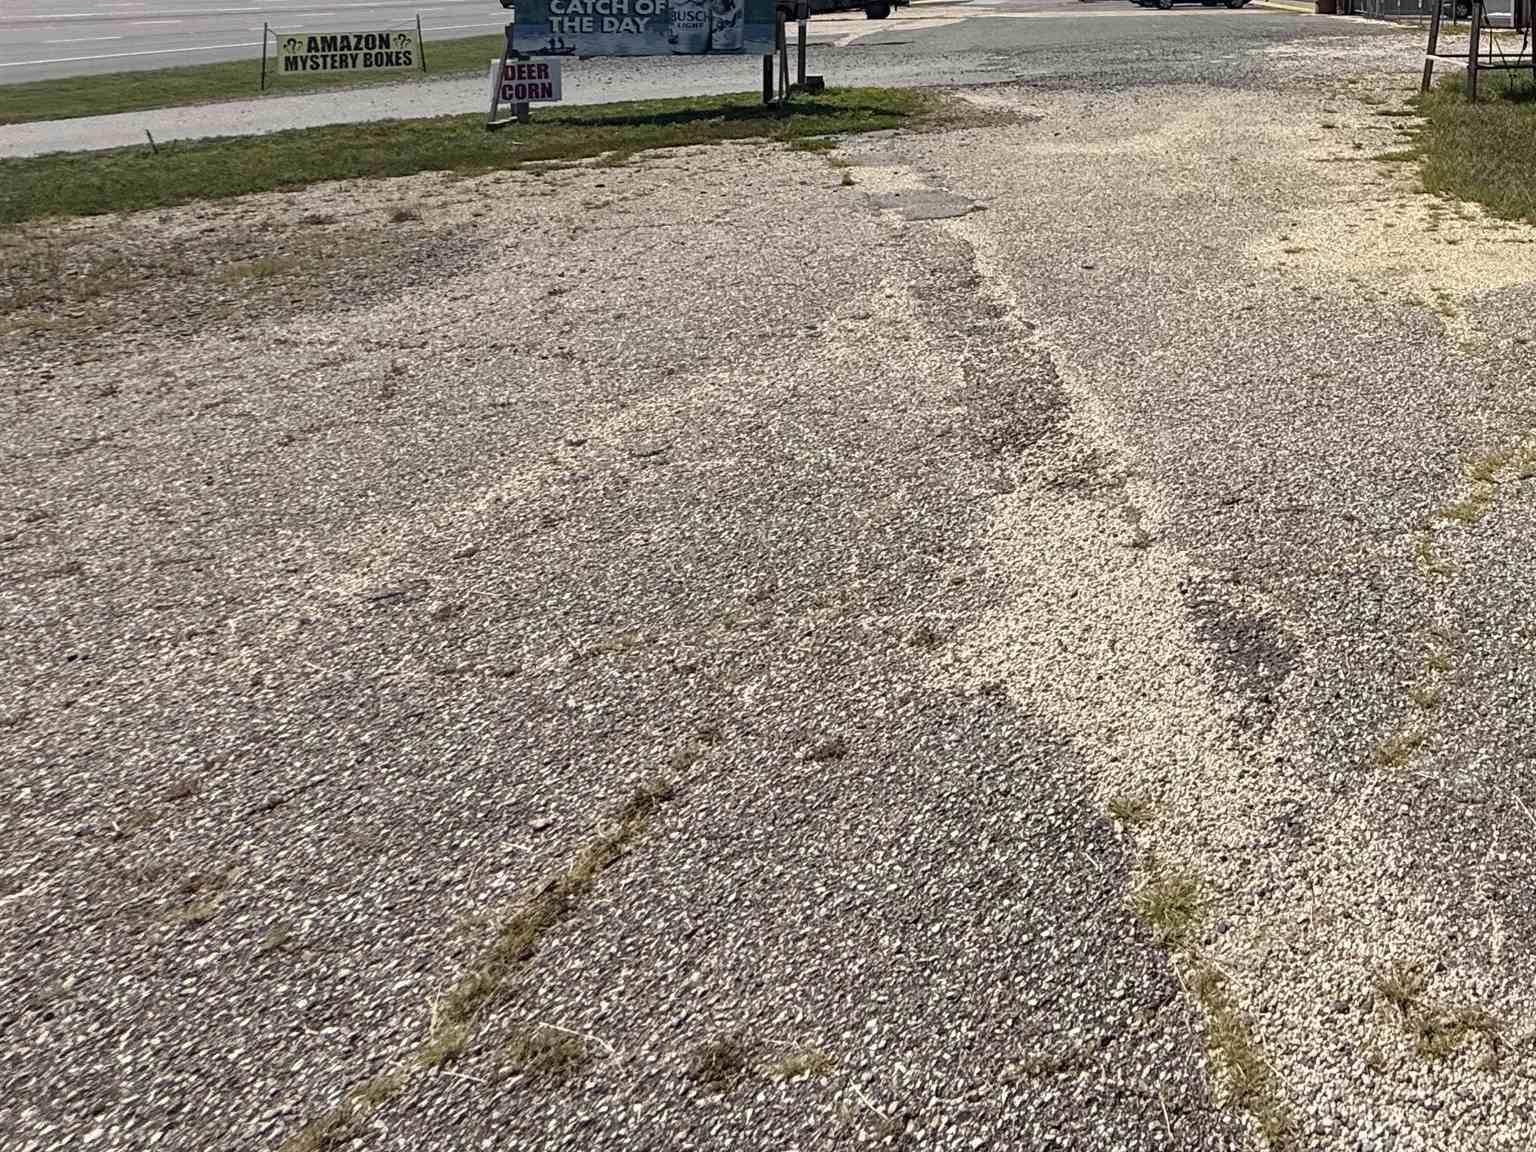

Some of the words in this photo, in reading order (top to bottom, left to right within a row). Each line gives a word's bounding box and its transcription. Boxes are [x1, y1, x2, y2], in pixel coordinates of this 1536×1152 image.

[549, 16, 594, 35] THE
[600, 16, 650, 35] DAY
[306, 33, 391, 54] AMAZON
[284, 52, 359, 72] MYSTERY
[363, 50, 413, 68] BOXES
[503, 63, 549, 81] DEER
[501, 81, 553, 101] CORN
